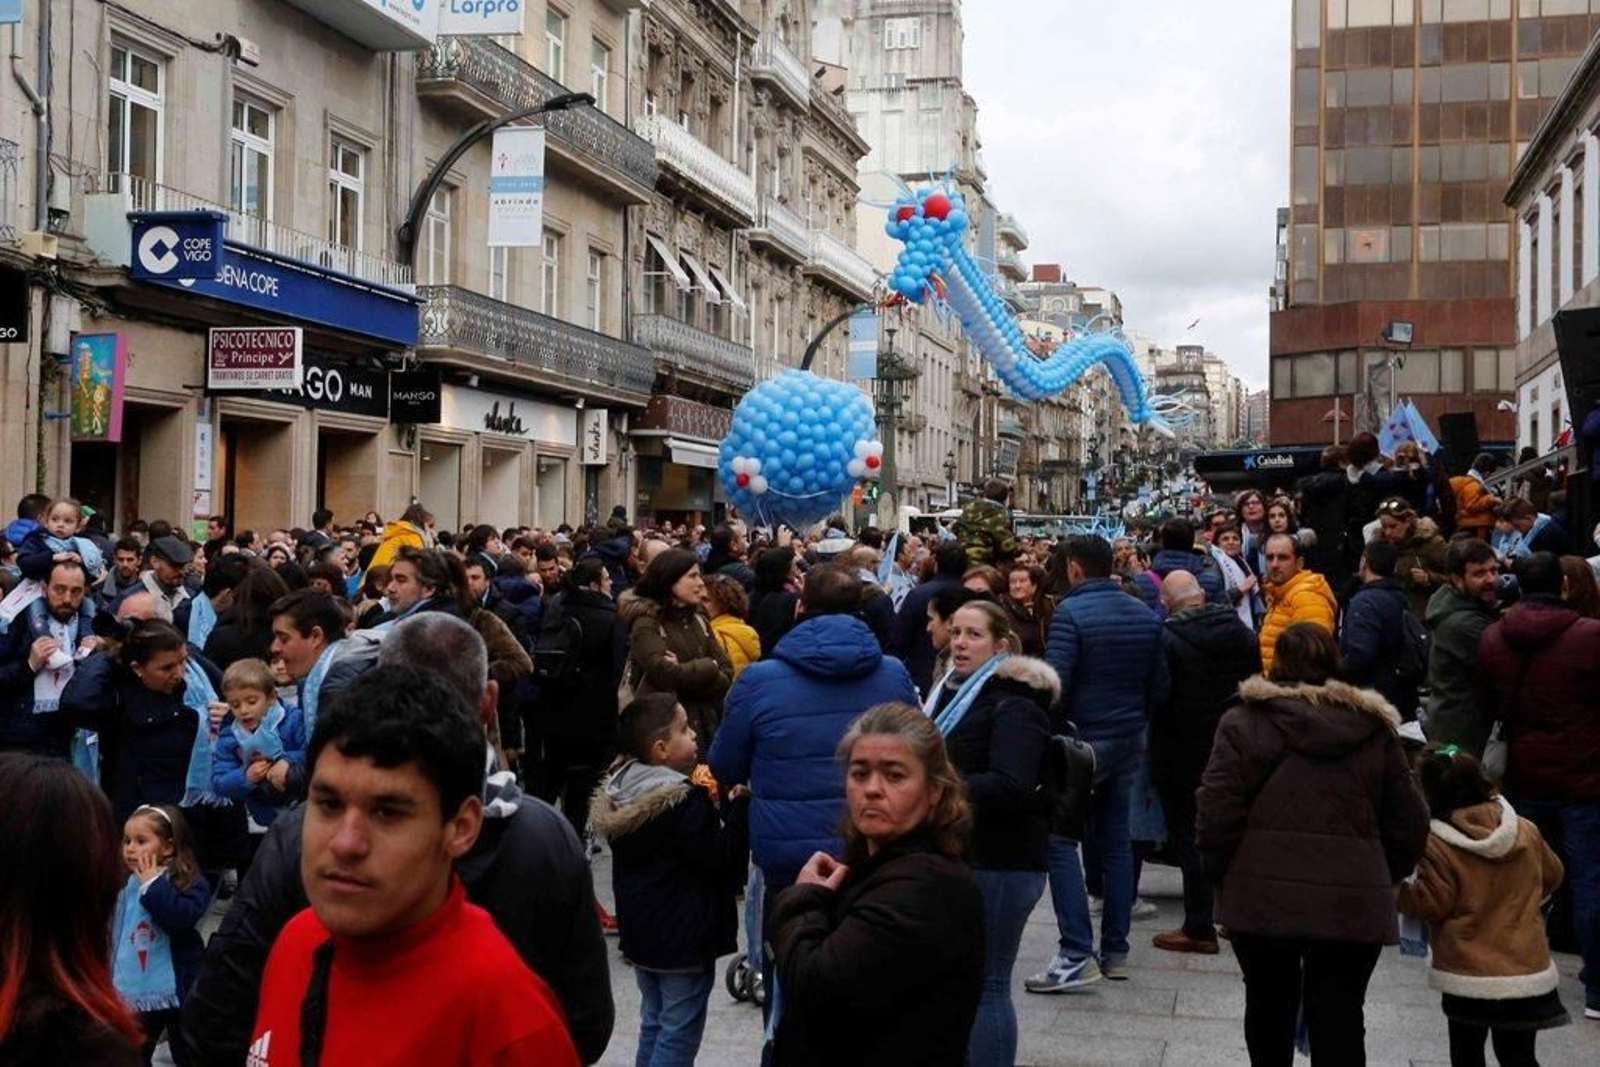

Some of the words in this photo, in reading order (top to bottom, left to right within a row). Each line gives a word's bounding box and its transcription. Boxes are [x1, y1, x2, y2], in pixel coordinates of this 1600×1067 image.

[183, 238, 211, 249] COPE
[183, 251, 212, 262] VIGO
[249, 272, 279, 298] COPE
[213, 331, 295, 349] PSICOTECNICO
[231, 350, 275, 366] Principe
[350, 382, 373, 399] MAN
[393, 390, 435, 401] MANGO
[1257, 454, 1295, 466] CaixaBank
